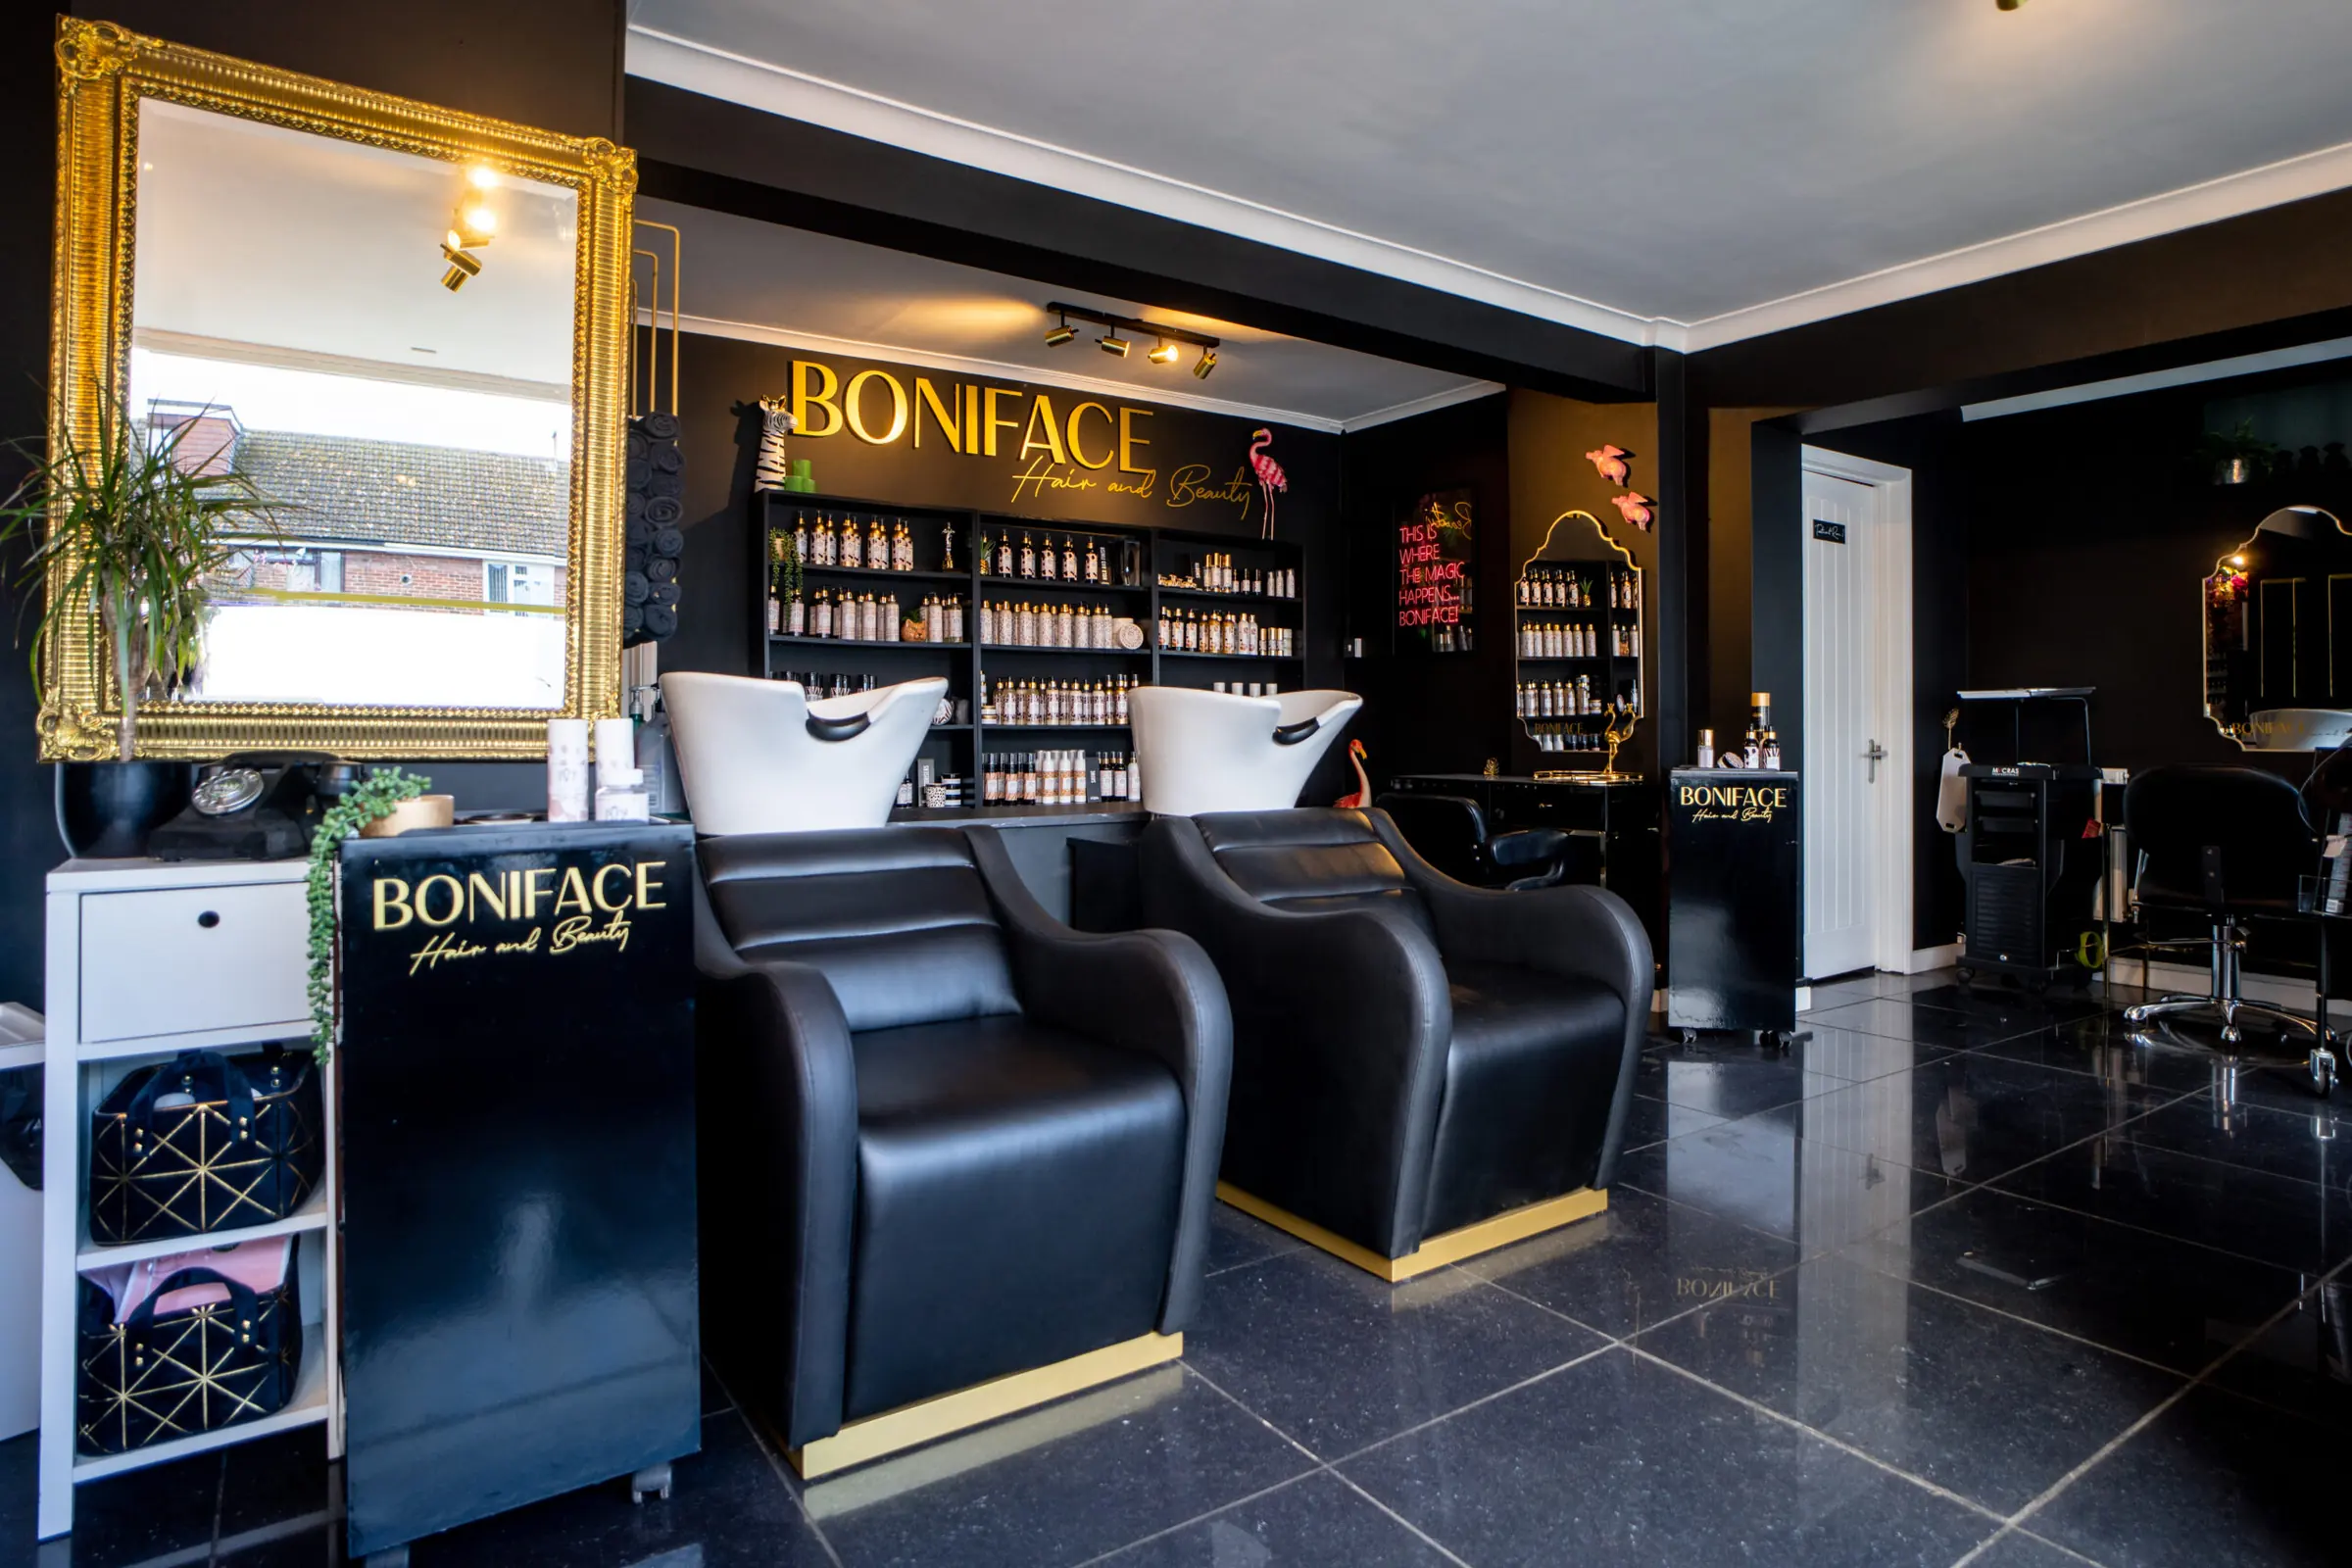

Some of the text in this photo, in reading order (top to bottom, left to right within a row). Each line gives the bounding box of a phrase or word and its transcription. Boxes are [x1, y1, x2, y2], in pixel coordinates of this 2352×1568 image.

[792, 360, 1155, 473] BONIFACE
[1011, 455, 1252, 521] Hair and Beauty
[1399, 524, 1438, 544] THIS IS
[1399, 544, 1440, 564] WHERE
[1399, 562, 1465, 585] THE MAGIC
[1399, 585, 1460, 607] HAPPENS...
[1399, 606, 1459, 626] BONIFACE!
[1681, 786, 1787, 808] BONIFACE
[1740, 806, 1773, 823] Beauty
[373, 861, 666, 931] BONIFACE
[410, 909, 632, 976] Hair and Beauty
